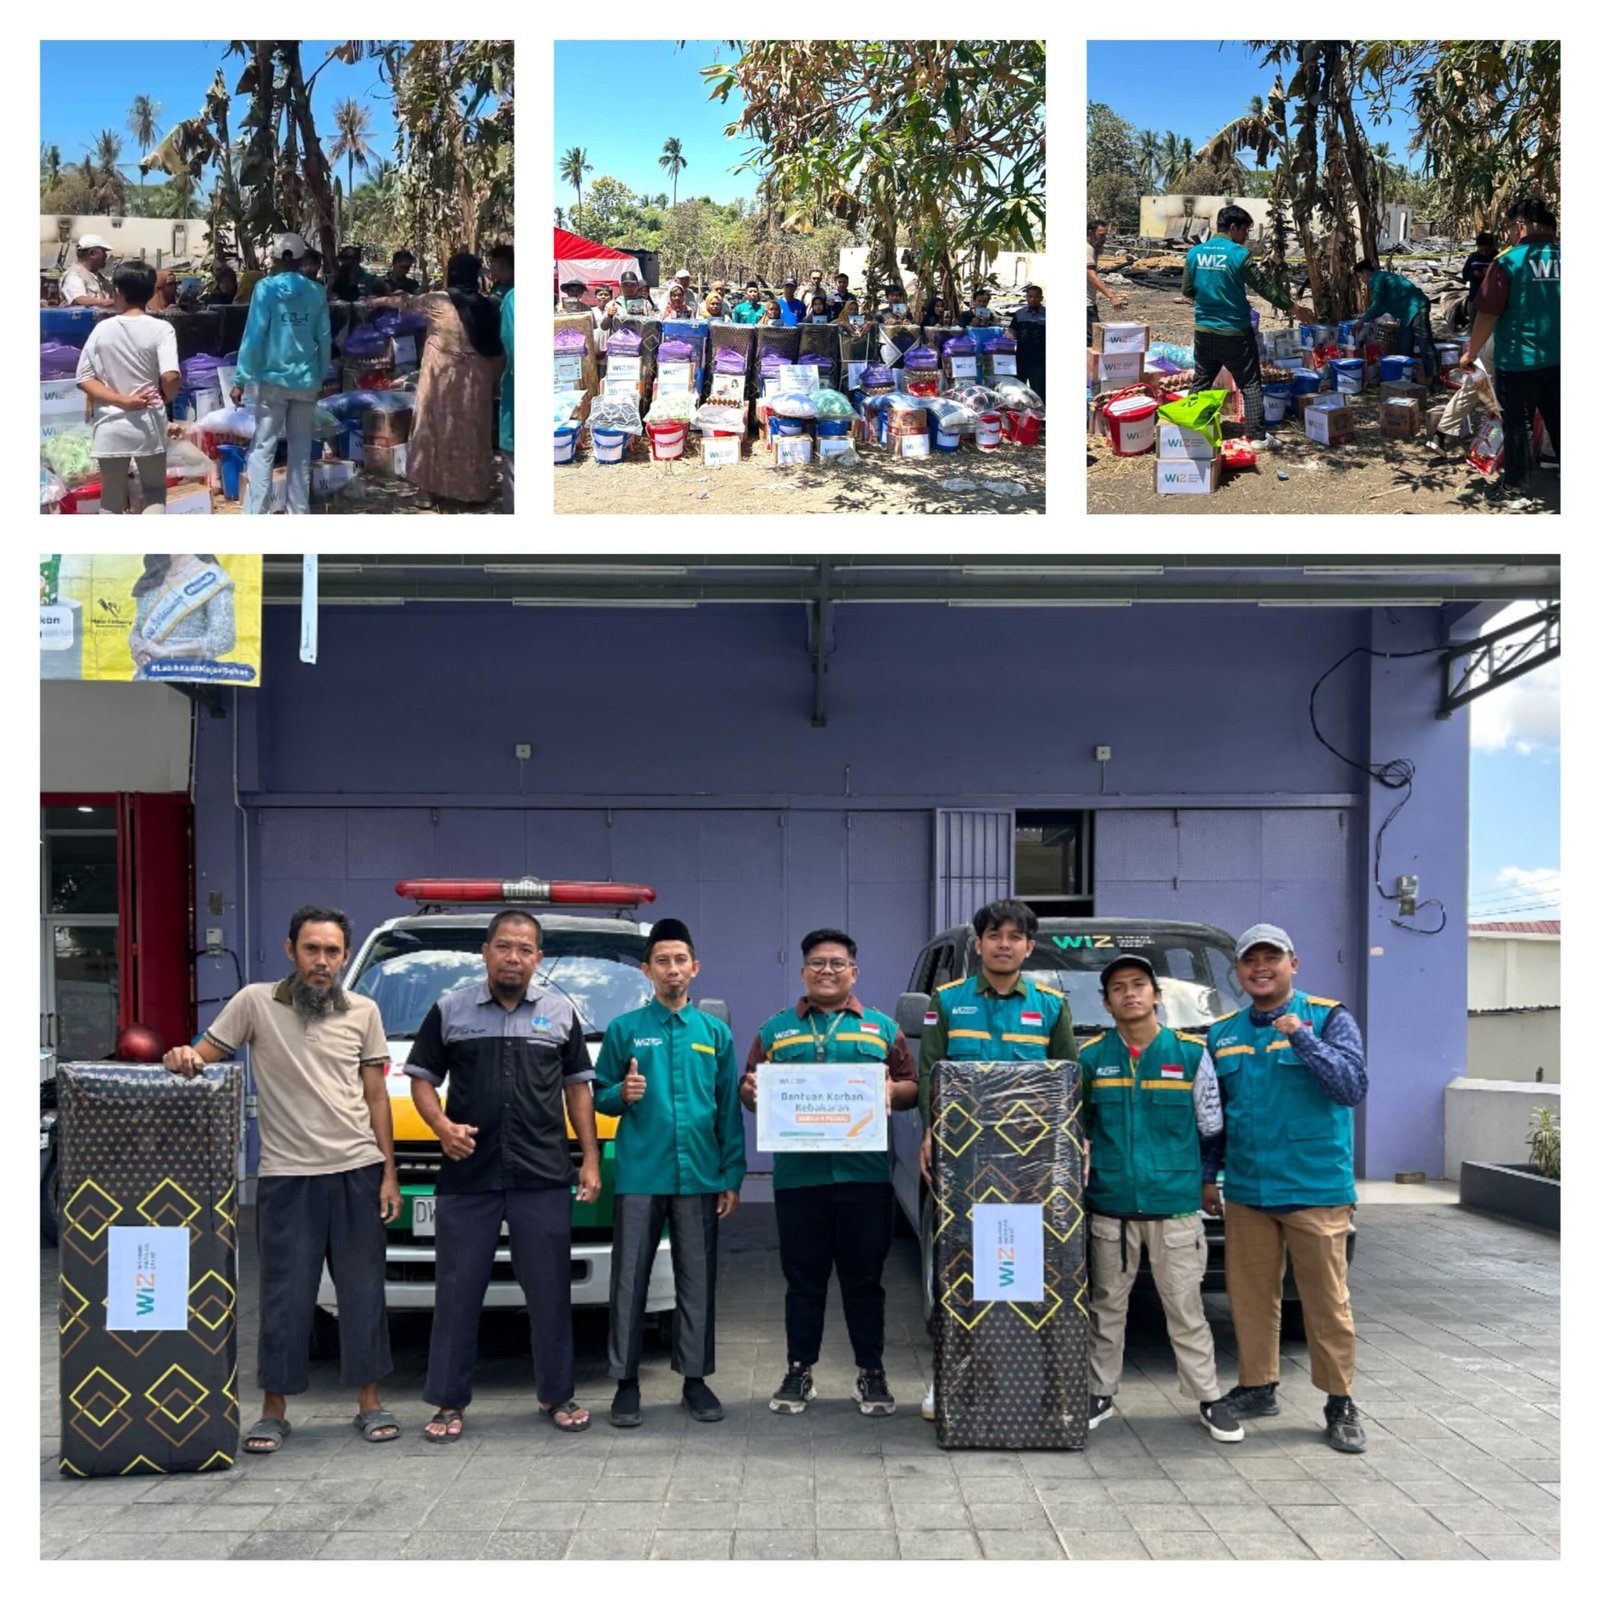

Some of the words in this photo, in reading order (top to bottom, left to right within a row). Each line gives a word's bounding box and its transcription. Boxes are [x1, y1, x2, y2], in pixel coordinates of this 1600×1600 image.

[1529, 259, 1560, 278] Wi
[781, 1091, 824, 1101] Bantuan
[826, 1091, 864, 1101] Korban
[795, 1103, 850, 1112] Kebakaran
